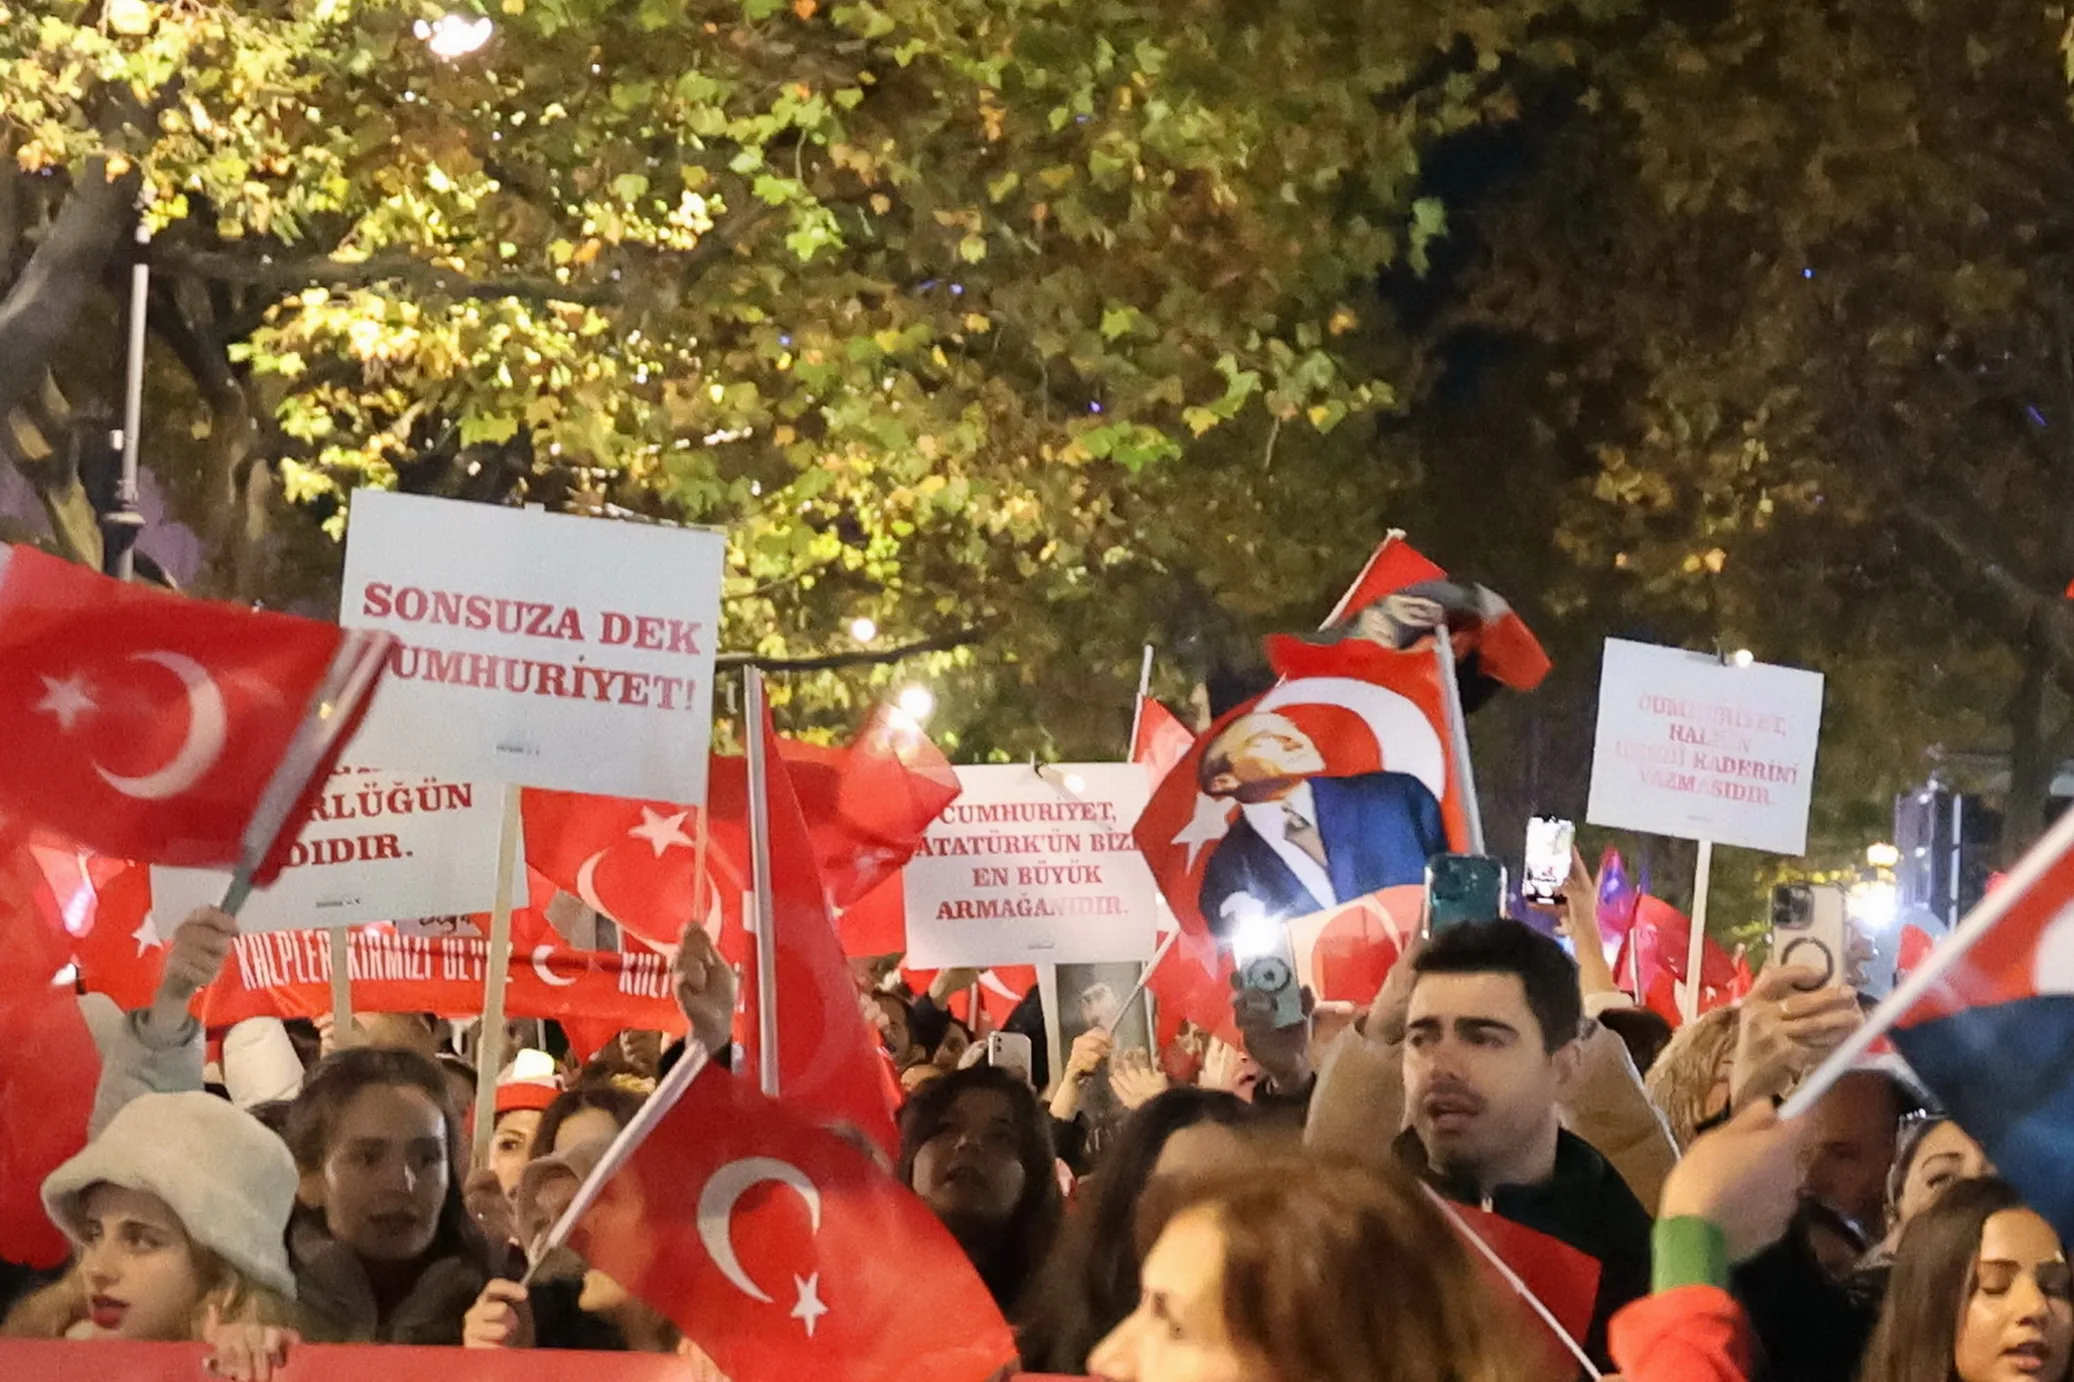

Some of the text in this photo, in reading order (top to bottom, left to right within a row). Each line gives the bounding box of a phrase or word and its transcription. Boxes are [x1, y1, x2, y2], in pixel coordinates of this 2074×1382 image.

[363, 582, 702, 656] SONSUZA DEK
[389, 643, 697, 712] UMHURİYET!
[307, 776, 473, 822] RLÜĞÜN
[939, 795, 1117, 825] CUMHURİYET,
[285, 833, 413, 869] DIDIR.
[915, 828, 1081, 858] ATATÜRK'ÜN
[972, 859, 1103, 887] EN BÜYÜK
[936, 891, 1129, 920] ARMAĞANIDIR.
[233, 929, 332, 992] KALPLER
